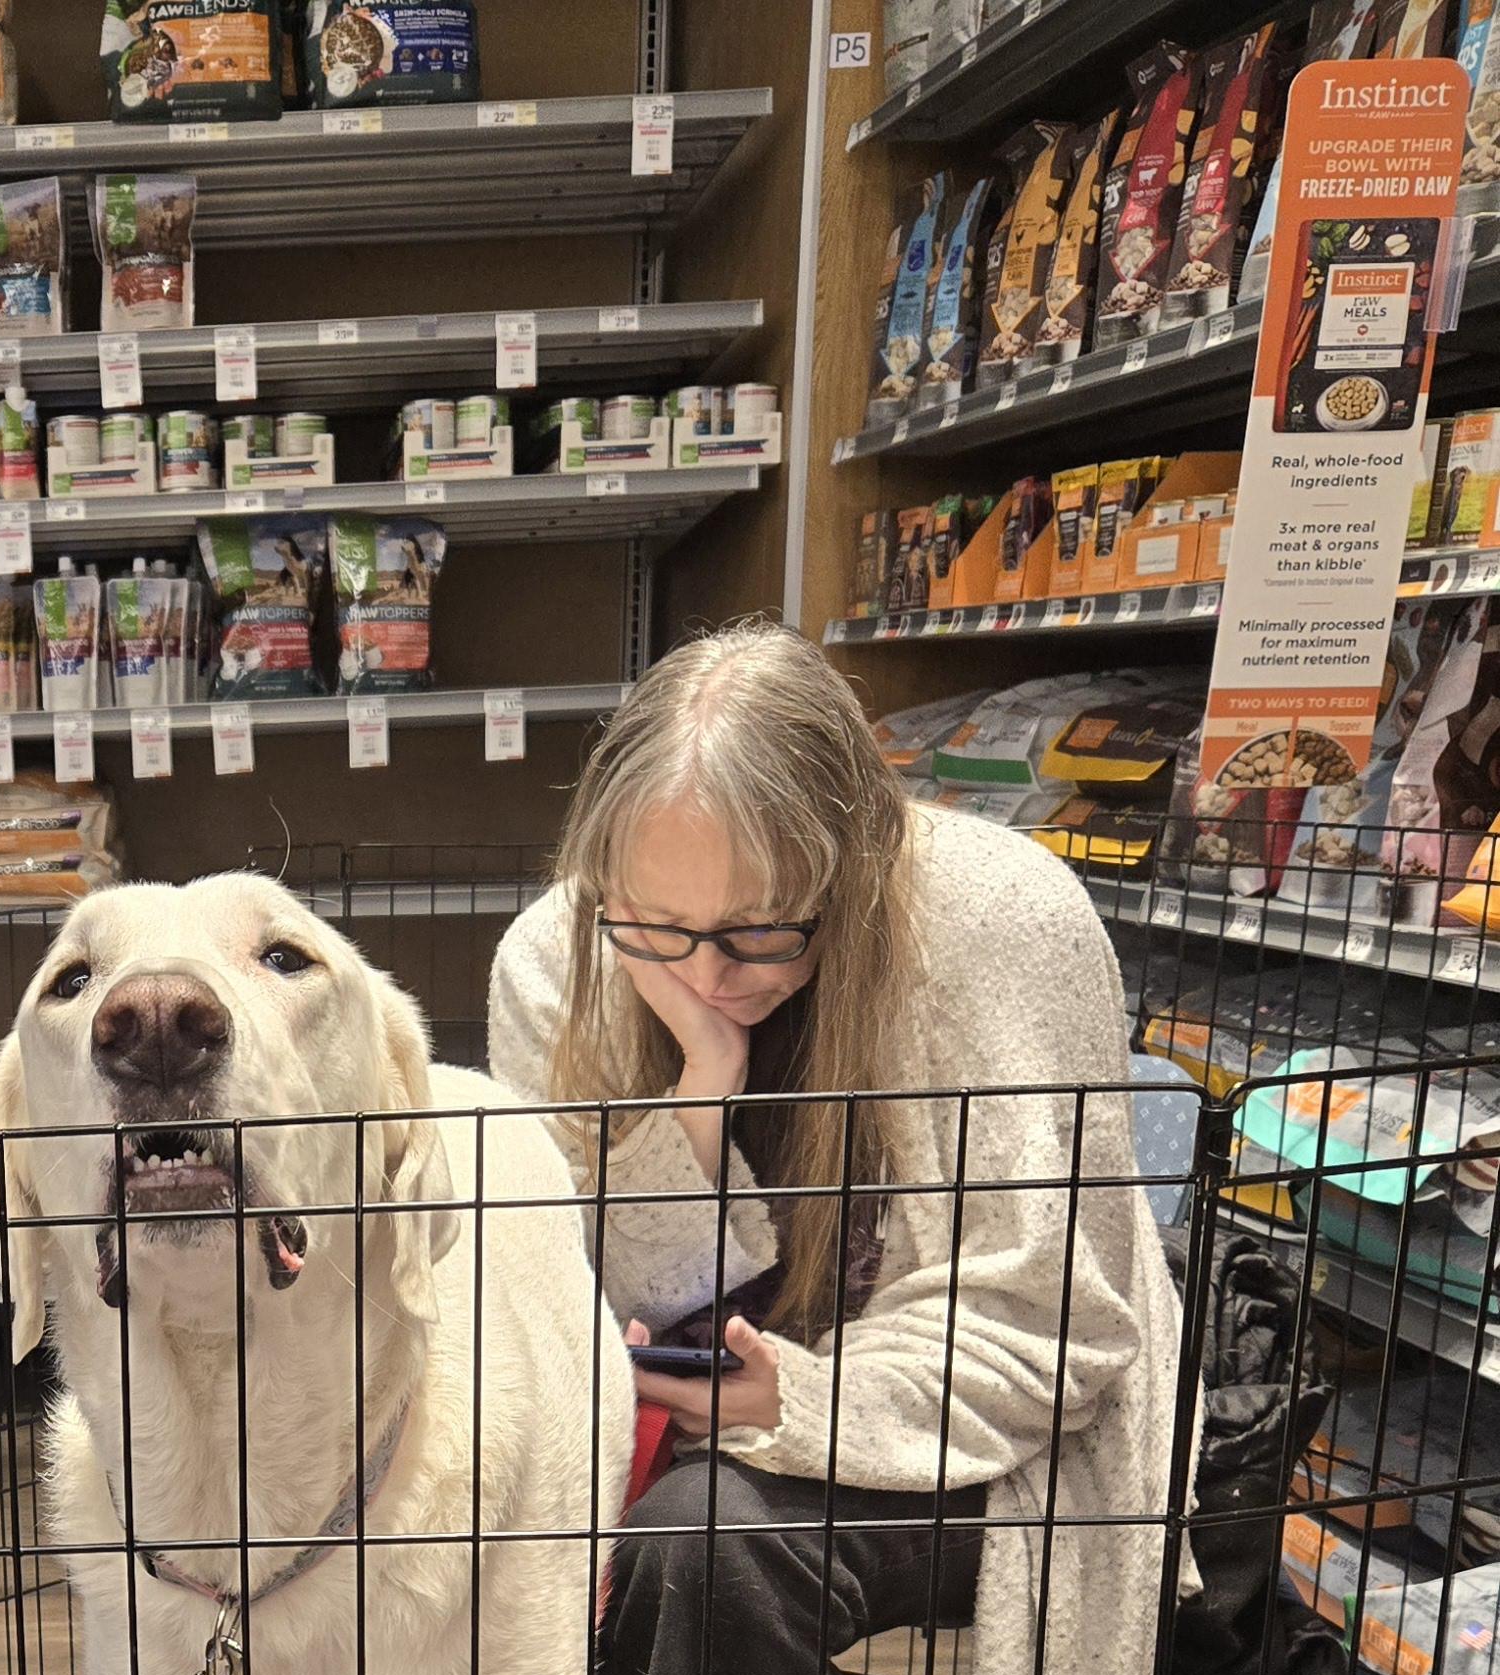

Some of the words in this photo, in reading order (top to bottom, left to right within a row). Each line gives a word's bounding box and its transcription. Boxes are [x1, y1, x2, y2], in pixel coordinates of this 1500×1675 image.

[834, 37, 867, 62] P5
[1319, 78, 1453, 110] Instinct
[1309, 139, 1398, 155] UPGRADE
[1402, 138, 1452, 152] THEIR
[1326, 159, 1378, 173] BOWL
[1385, 157, 1431, 171] WITH
[1300, 178, 1412, 199] FREEZE-DRIED
[1414, 176, 1452, 197] RAW
[1336, 270, 1403, 288] Instinct
[1352, 296, 1381, 306] raw
[1343, 307, 1387, 318] MEALS
[1272, 455, 1309, 471] Real,
[1315, 453, 1403, 468] whole-food
[1290, 474, 1378, 490] ingredients
[1279, 522, 1297, 535] 3x
[1302, 522, 1341, 534] more
[1347, 520, 1376, 534] real
[1269, 540, 1308, 553] meat
[1312, 539, 1323, 551] &
[1327, 539, 1380, 554] organs
[1277, 558, 1311, 571] than
[1299, 578, 1304, 586] to
[1305, 577, 1327, 586] Instinct
[1329, 576, 1353, 588] Original
[1238, 618, 1306, 634] Minimally
[1310, 617, 1386, 633] processed
[1260, 636, 1282, 650] for
[1285, 637, 1357, 648] maximum
[1241, 653, 1300, 667] nutrient
[1304, 652, 1371, 666] retention
[1229, 698, 1263, 710] TWO
[1266, 698, 1304, 709] WAYS
[1307, 697, 1326, 709] TO
[1329, 696, 1371, 709] FEED!
[1235, 720, 1259, 733] Meal
[1329, 719, 1361, 735] Topper
